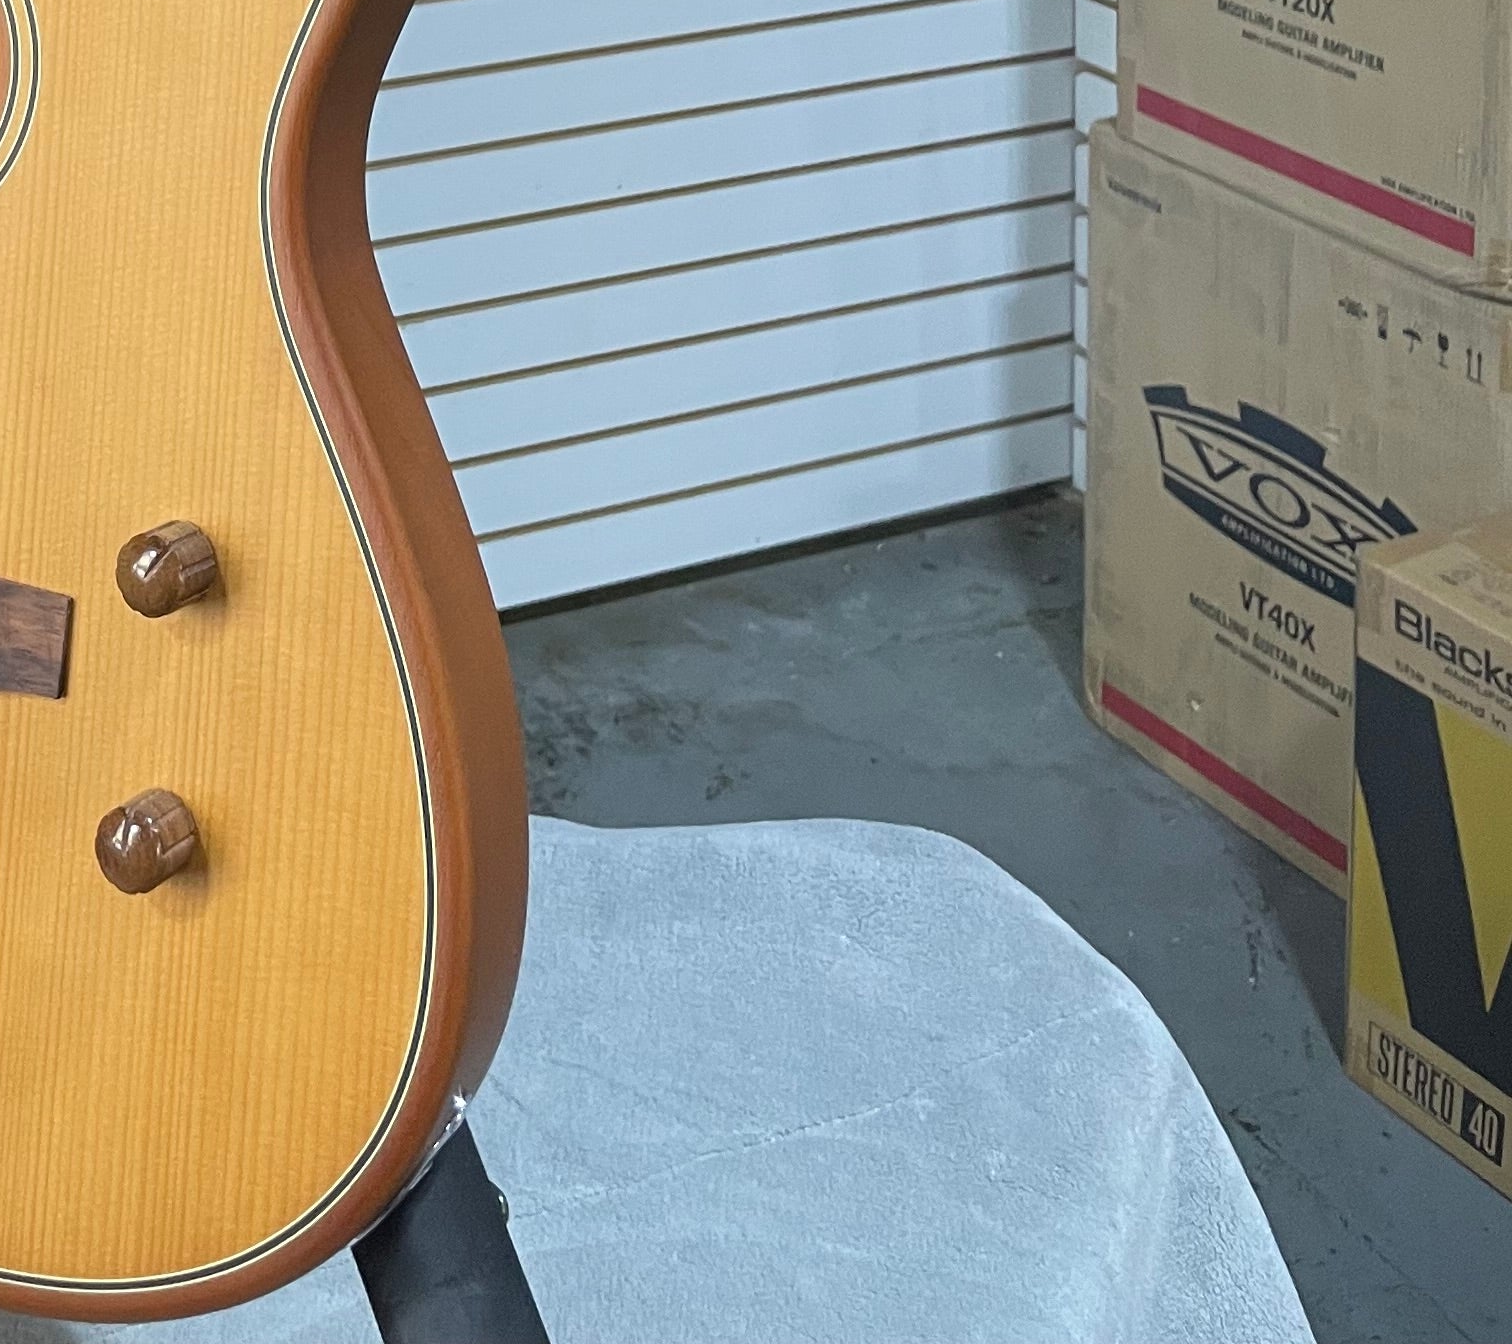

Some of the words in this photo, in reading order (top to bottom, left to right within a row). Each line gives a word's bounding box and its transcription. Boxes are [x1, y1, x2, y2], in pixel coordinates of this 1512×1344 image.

[1175, 425, 1380, 559] VOX
[1239, 580, 1316, 654] VT40X
[1377, 1032, 1455, 1126] STEREO
[1468, 1100, 1499, 1157] 40
